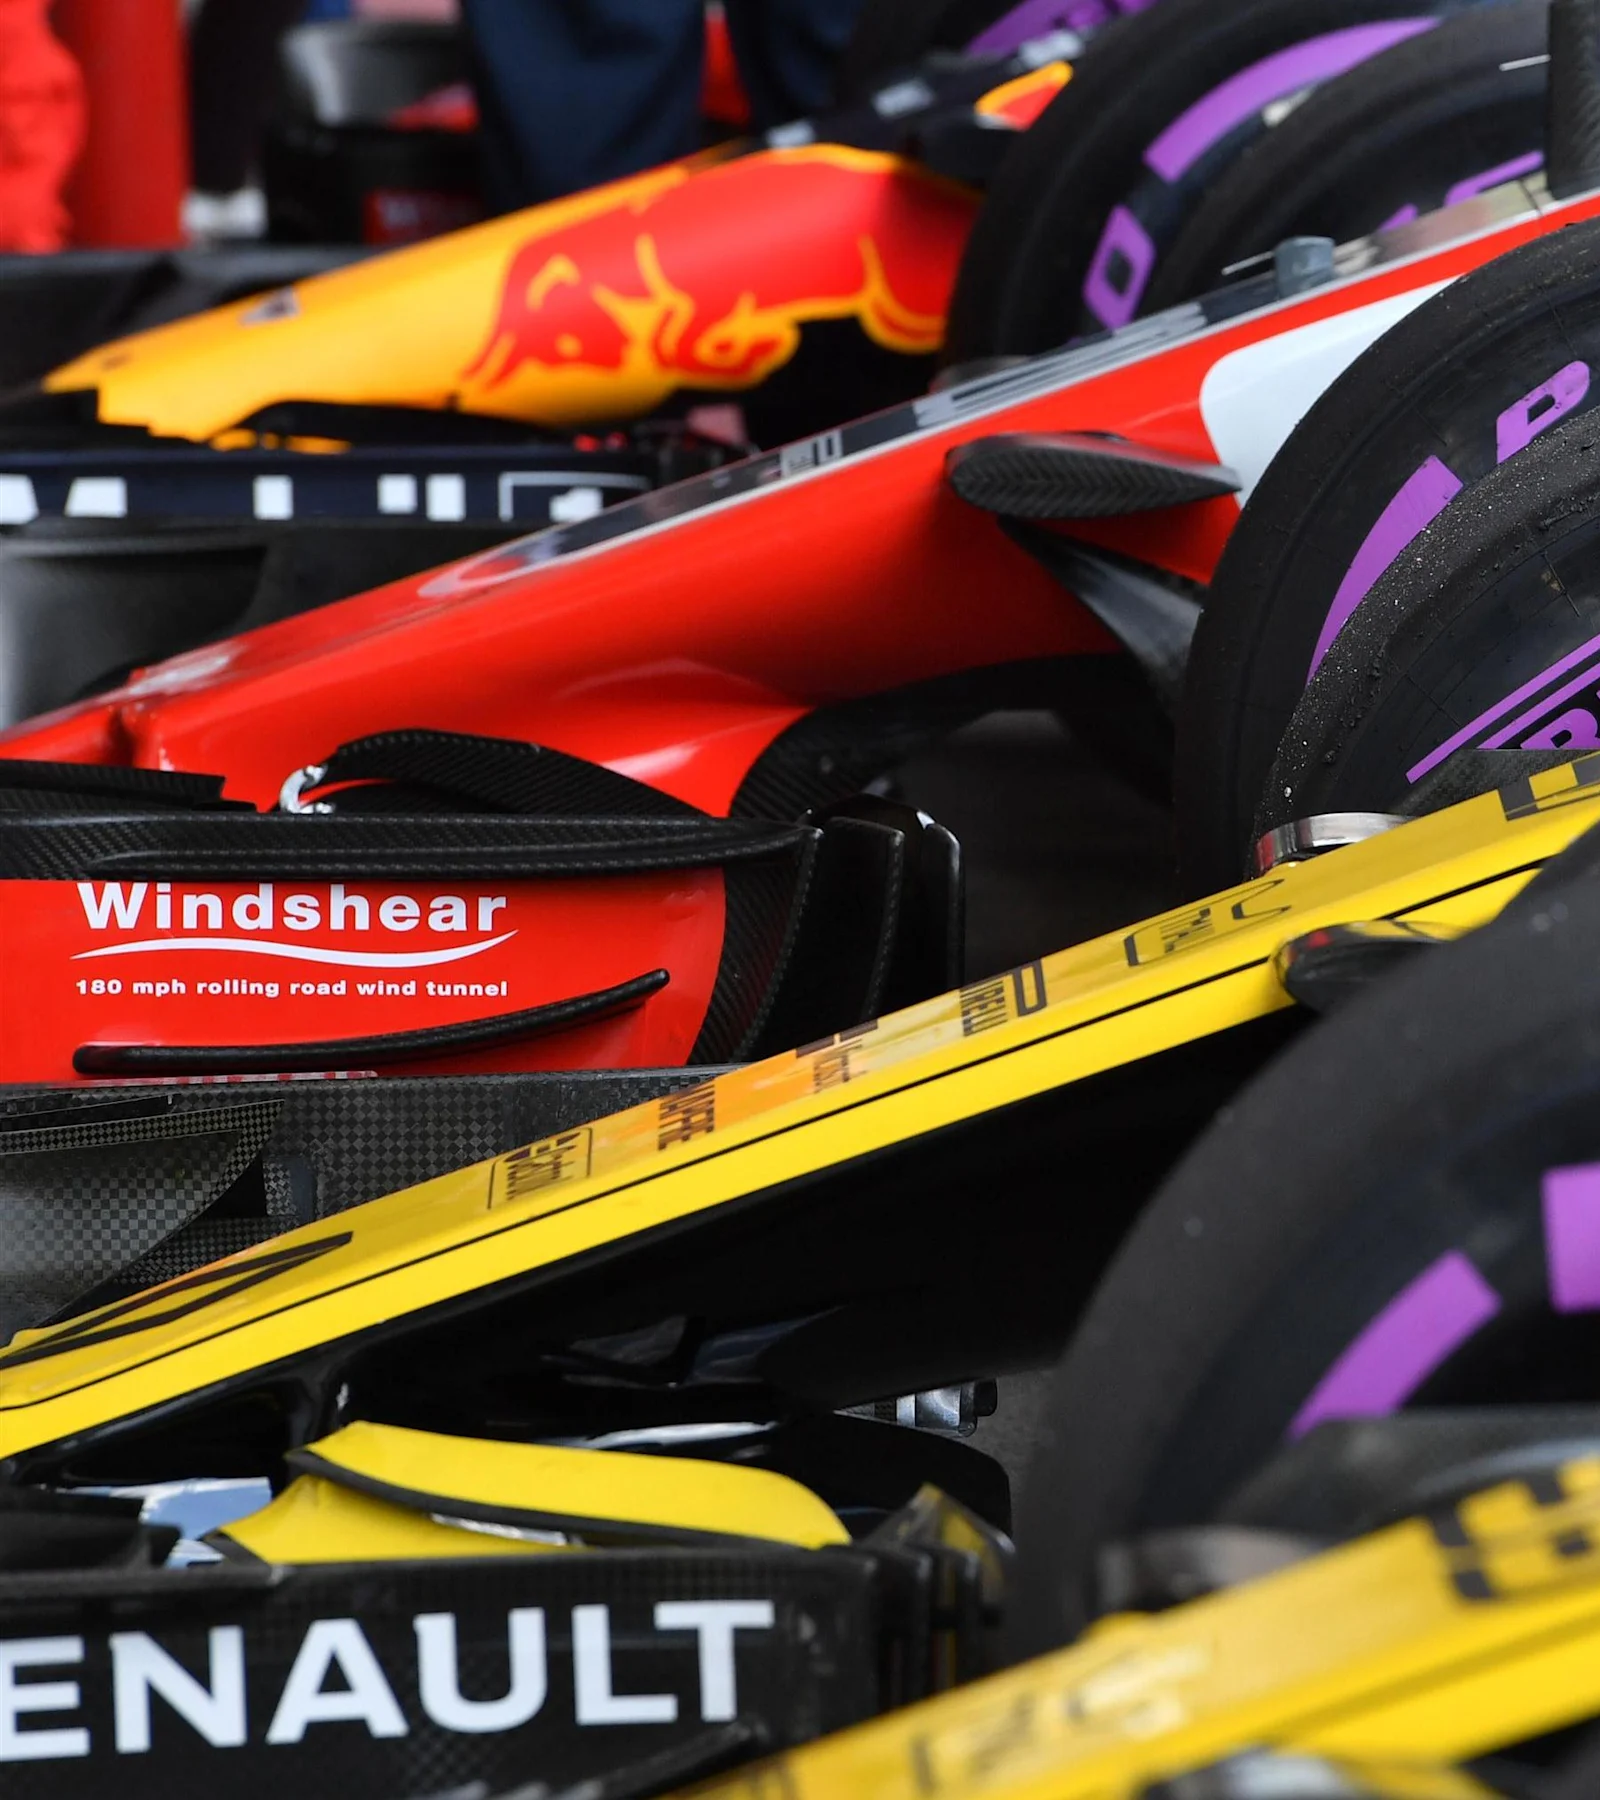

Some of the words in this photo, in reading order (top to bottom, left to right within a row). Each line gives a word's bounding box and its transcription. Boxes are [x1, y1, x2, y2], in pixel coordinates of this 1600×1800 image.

[77, 882, 507, 932] Windshear
[76, 979, 122, 995] 180
[132, 978, 186, 998] mph
[196, 979, 280, 998] rolling
[290, 979, 347, 996] road
[356, 980, 416, 996] wind
[425, 980, 507, 997] tunnel
[0, 1599, 776, 1762] ENAULT
